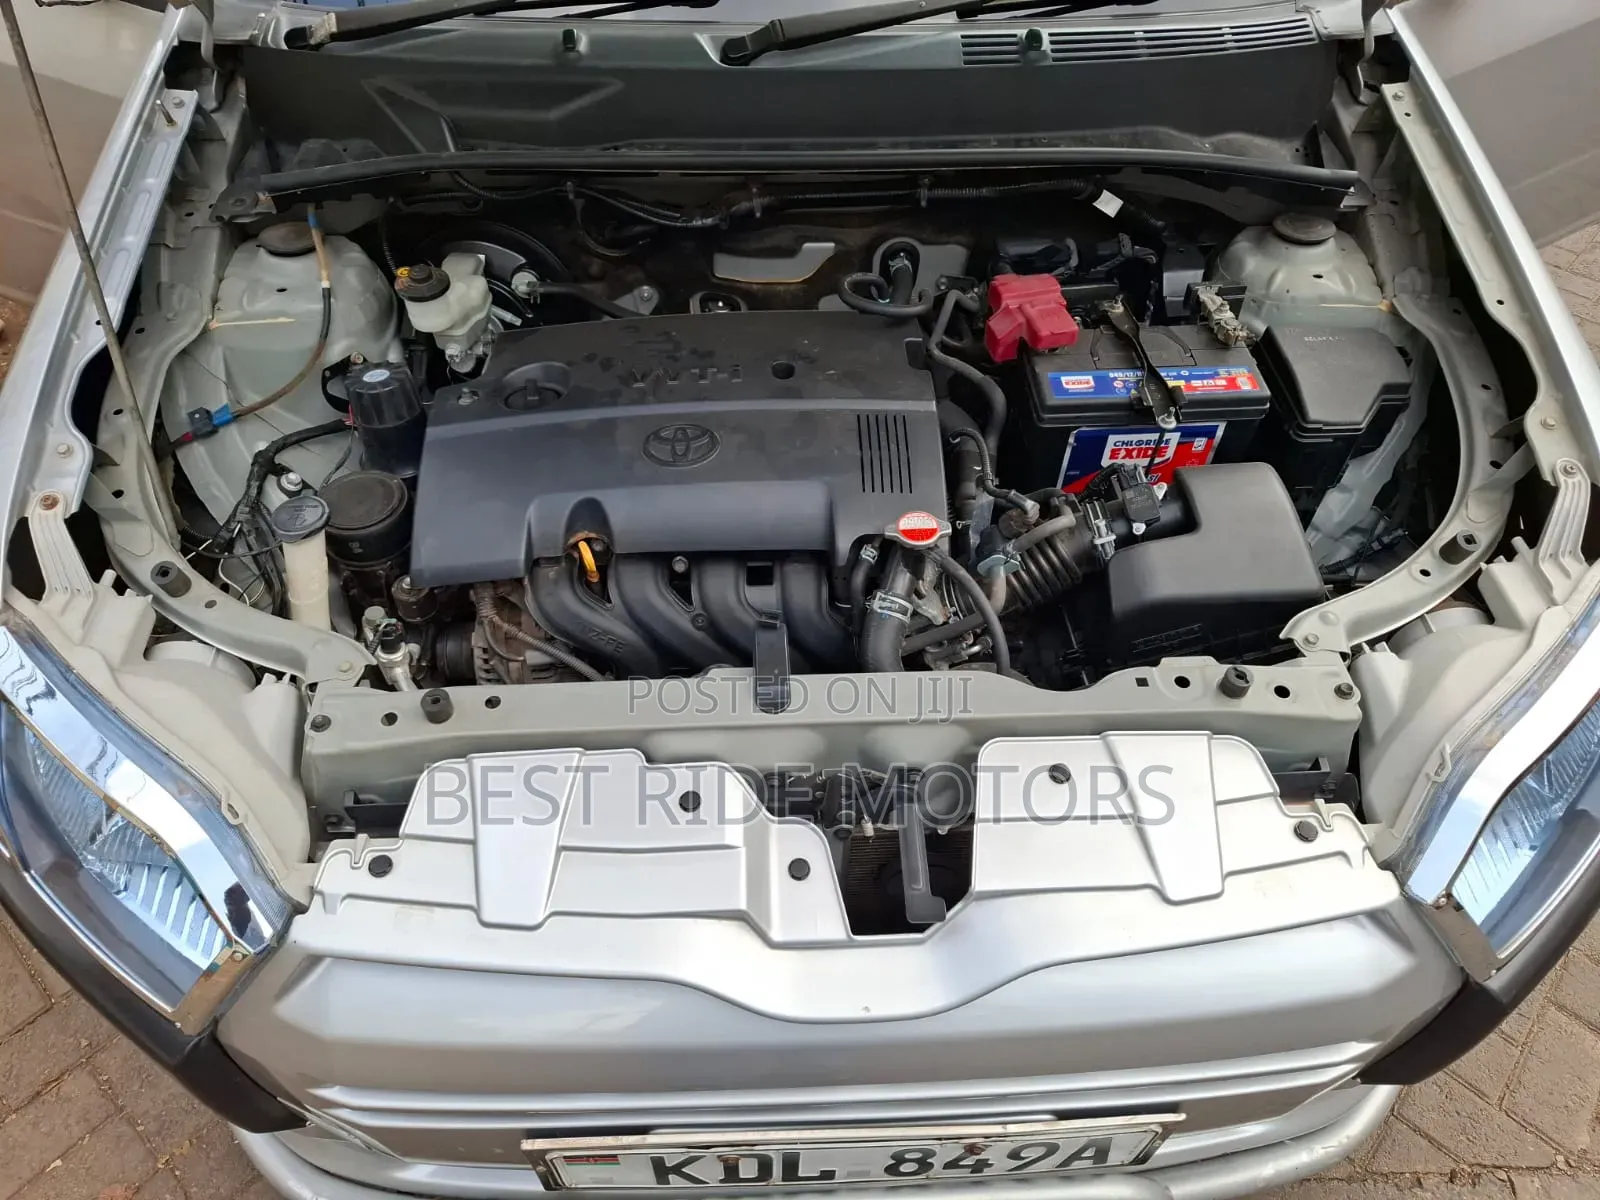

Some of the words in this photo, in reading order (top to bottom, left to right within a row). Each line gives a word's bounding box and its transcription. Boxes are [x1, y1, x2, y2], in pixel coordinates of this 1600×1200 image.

[1109, 446, 1169, 460] EXIDE
[650, 1151, 836, 1185] KDL
[884, 1136, 1113, 1177] 849A
